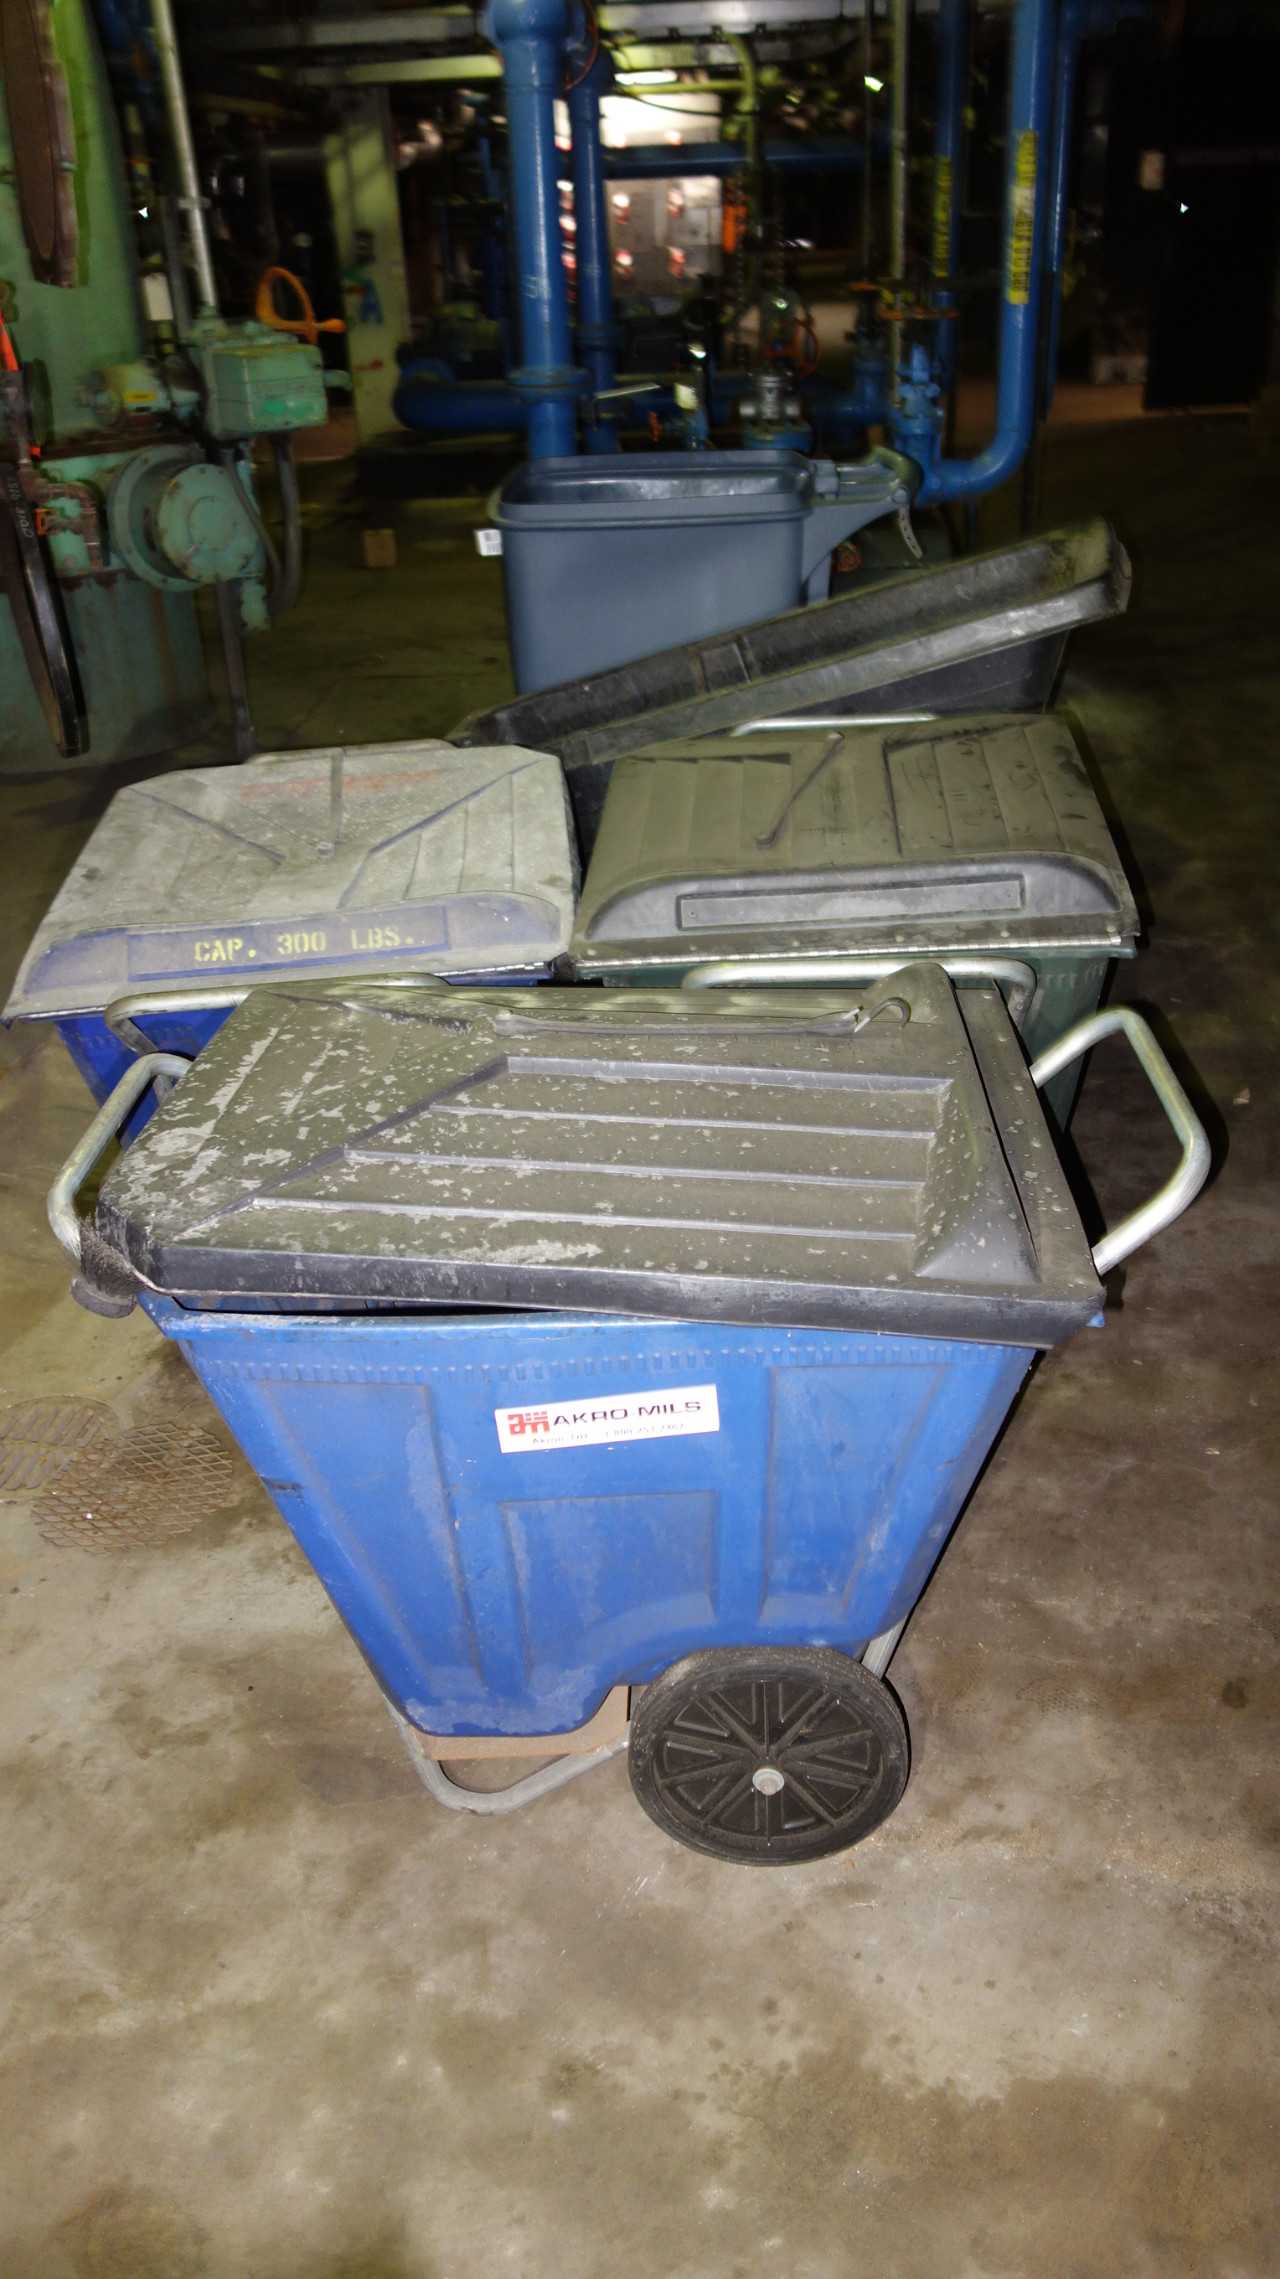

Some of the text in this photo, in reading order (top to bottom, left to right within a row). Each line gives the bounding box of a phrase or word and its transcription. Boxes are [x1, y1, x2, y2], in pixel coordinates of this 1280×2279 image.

[194, 927, 414, 962] CAP. 300 LBS.
[553, 1408, 628, 1426] AKRO
